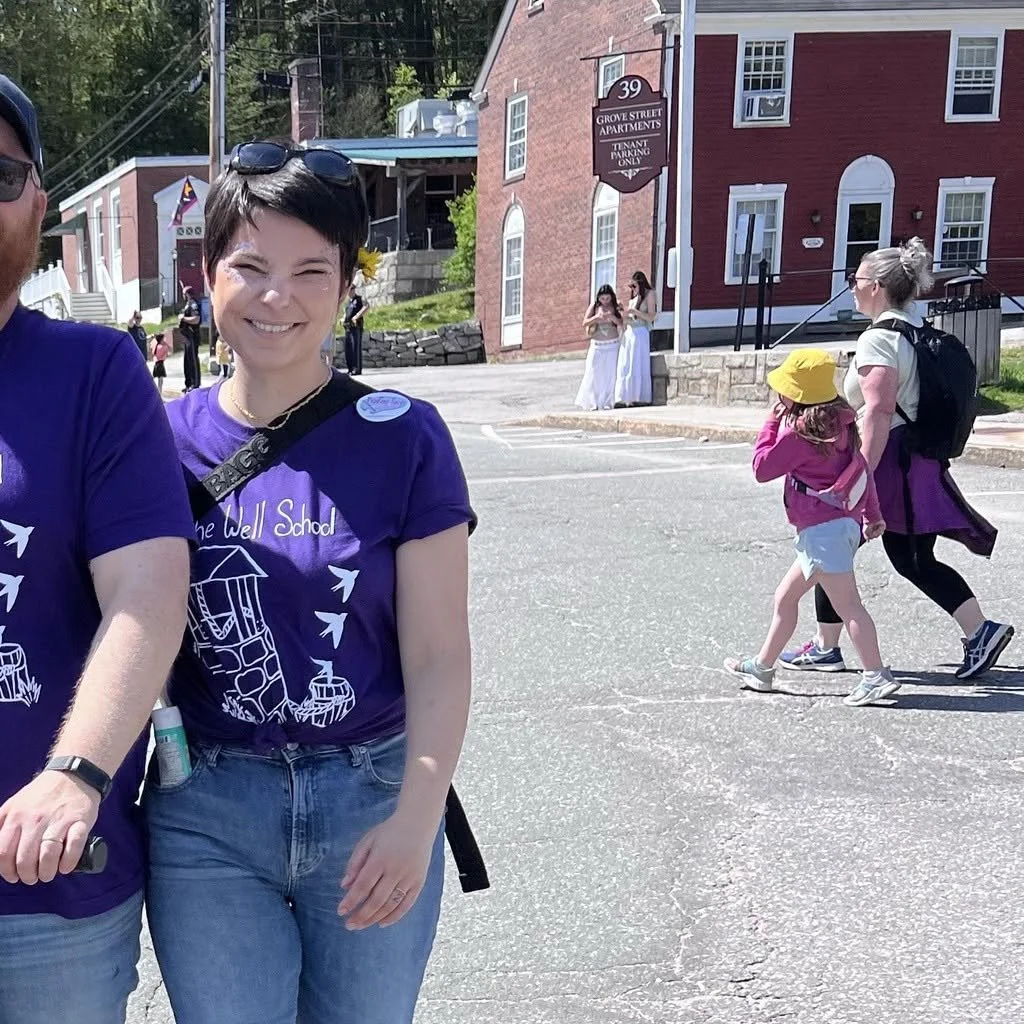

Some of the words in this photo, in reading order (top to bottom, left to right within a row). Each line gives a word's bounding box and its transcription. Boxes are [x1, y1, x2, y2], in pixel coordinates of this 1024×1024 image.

[617, 78, 642, 100] 39
[596, 112, 628, 125] GROVE
[629, 108, 663, 121] STREET
[599, 119, 662, 136] APARTMENTS
[610, 147, 651, 160] PARKING
[611, 139, 649, 151] TENANT
[618, 158, 642, 167] ONLY
[194, 520, 215, 541] he
[223, 500, 266, 540] Well
[274, 498, 336, 537] School
